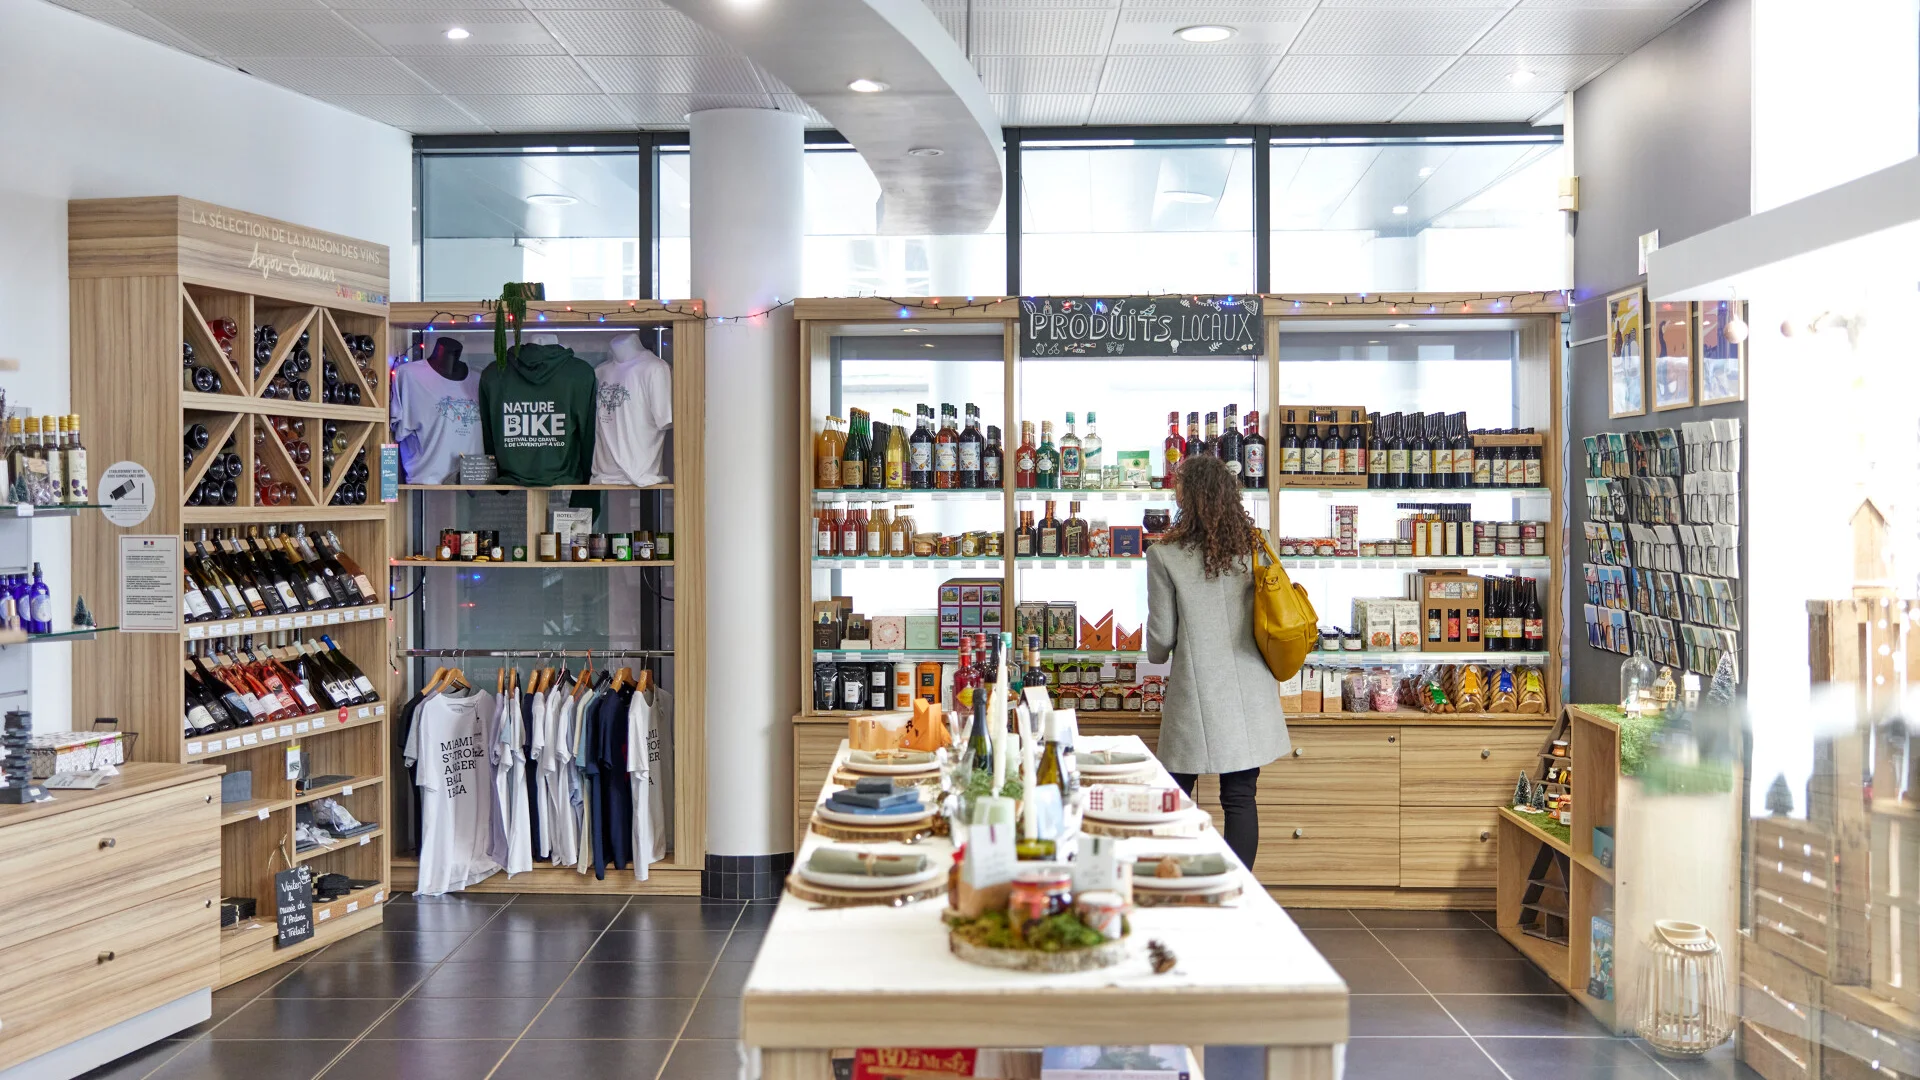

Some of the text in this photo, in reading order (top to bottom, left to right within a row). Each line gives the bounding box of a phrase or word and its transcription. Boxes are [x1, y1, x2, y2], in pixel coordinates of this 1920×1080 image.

[192, 210, 381, 265] LA SÉLECTION DE LA MAISON DES VINS
[1182, 312, 1254, 342] LOCAUX
[504, 401, 555, 414] NATURE
[504, 414, 566, 437] BIKE
[440, 736, 473, 752] MIAMI
[444, 760, 476, 775] ANGER
[281, 879, 303, 893] Visitez
